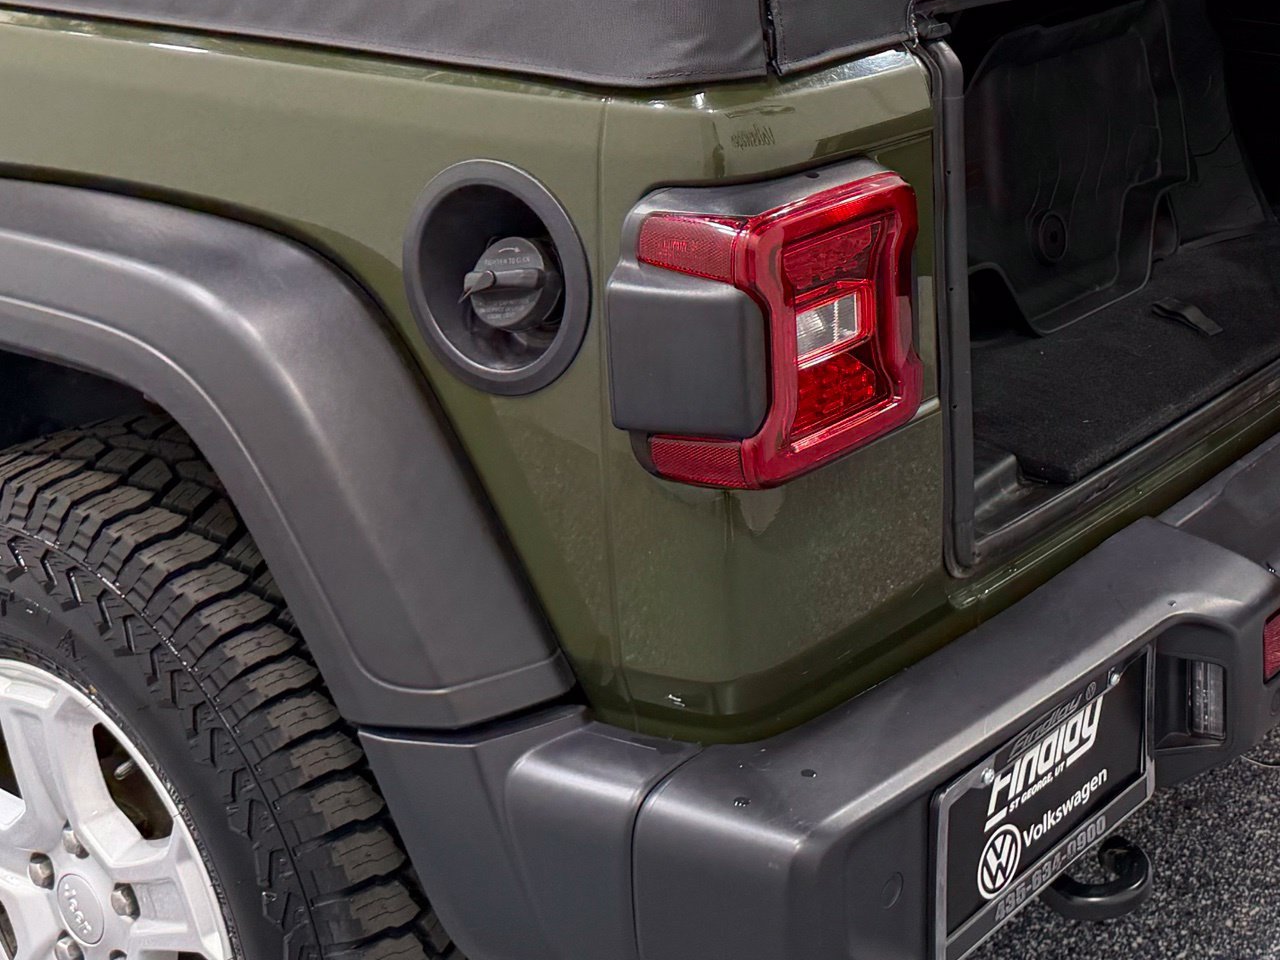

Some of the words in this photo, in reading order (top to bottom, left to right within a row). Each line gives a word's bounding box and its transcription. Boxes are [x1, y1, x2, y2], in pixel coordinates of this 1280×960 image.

[1009, 796, 1021, 813] ST
[1054, 760, 1066, 777] UT
[1022, 767, 1108, 848] Volkswagen
